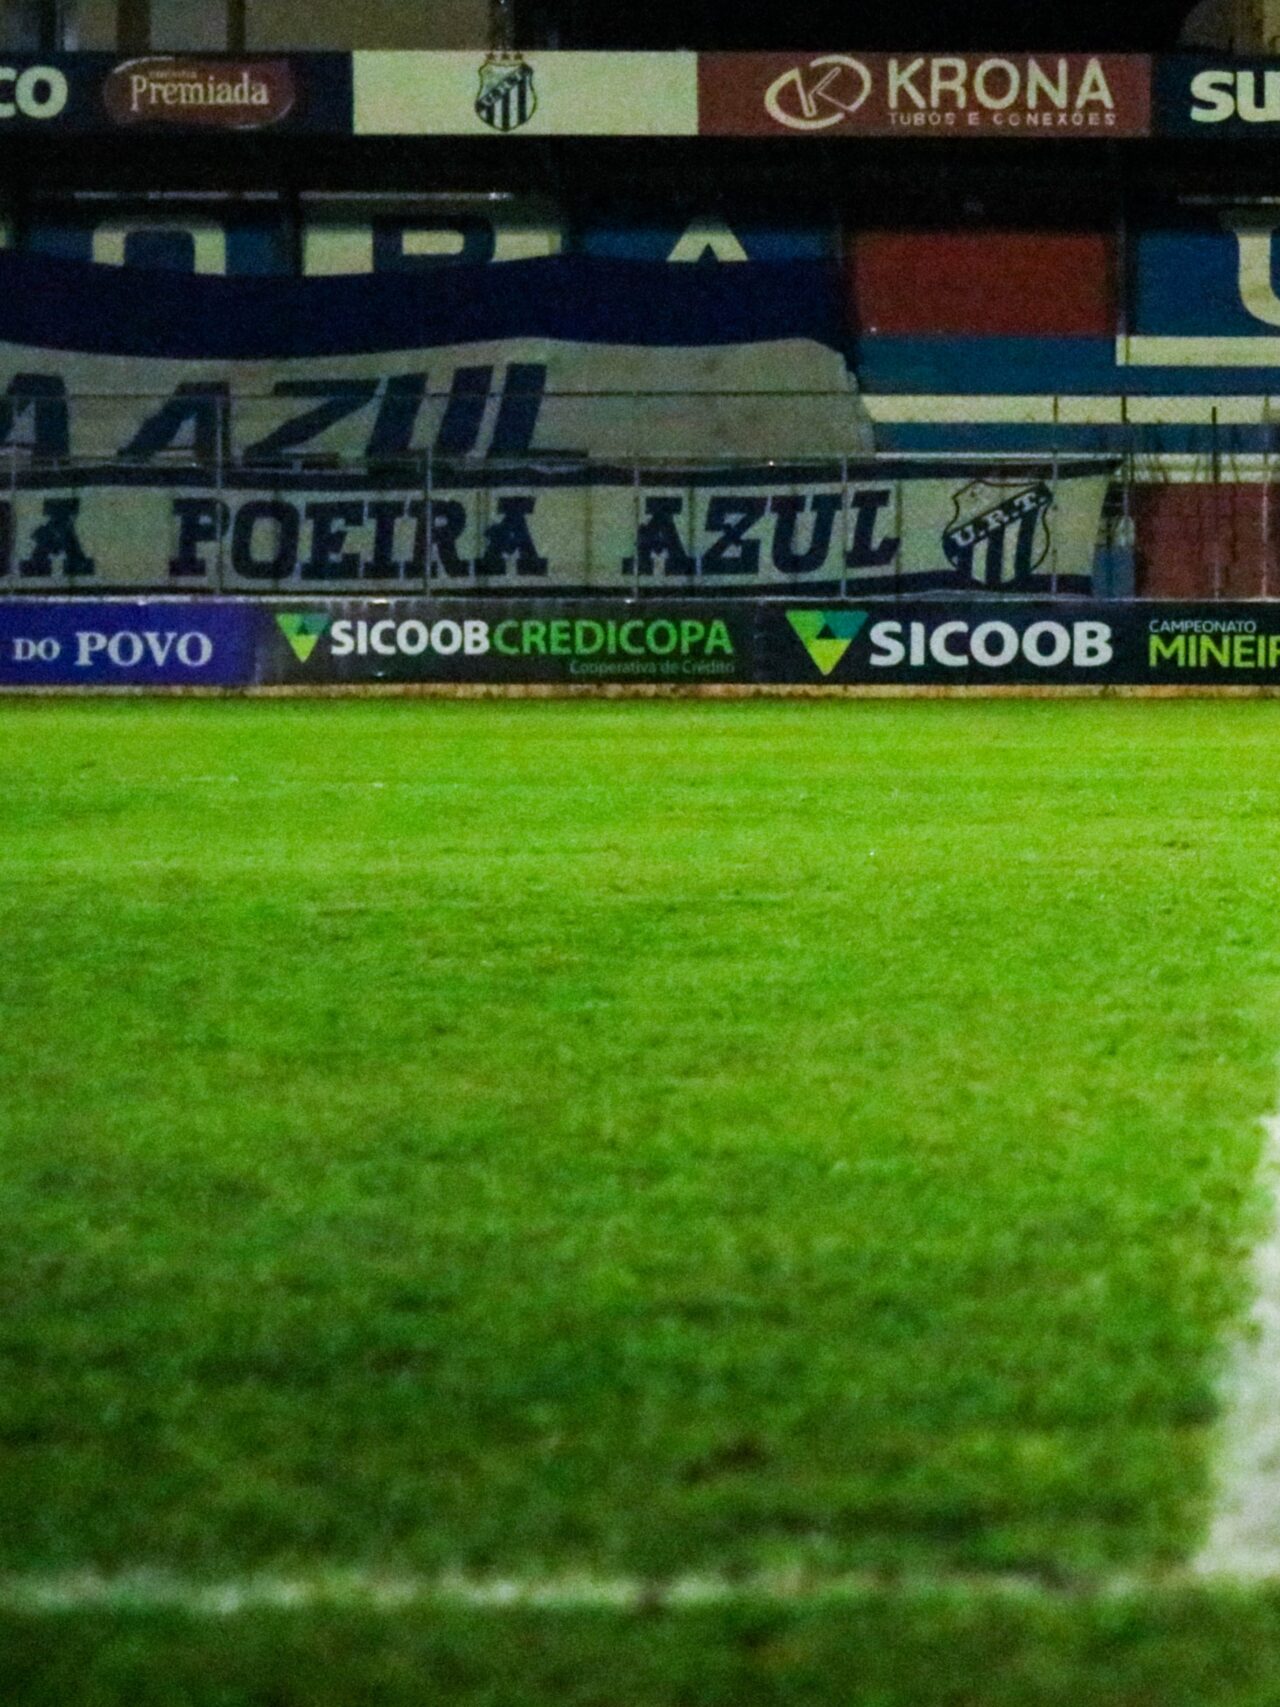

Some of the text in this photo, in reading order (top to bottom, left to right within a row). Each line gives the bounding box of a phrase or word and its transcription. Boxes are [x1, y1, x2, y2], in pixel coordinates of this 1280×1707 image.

[129, 72, 270, 111] Premiada
[887, 57, 1114, 109] KRONA
[888, 111, 956, 126] TUBOS
[967, 111, 981, 126] E
[168, 497, 548, 579] POEIRA
[622, 490, 898, 575] AZUL
[869, 621, 1113, 667] SICOOB
[1149, 619, 1256, 633] CAMPEONATO
[13, 632, 212, 667] DO POVO
[660, 659, 680, 674] de
